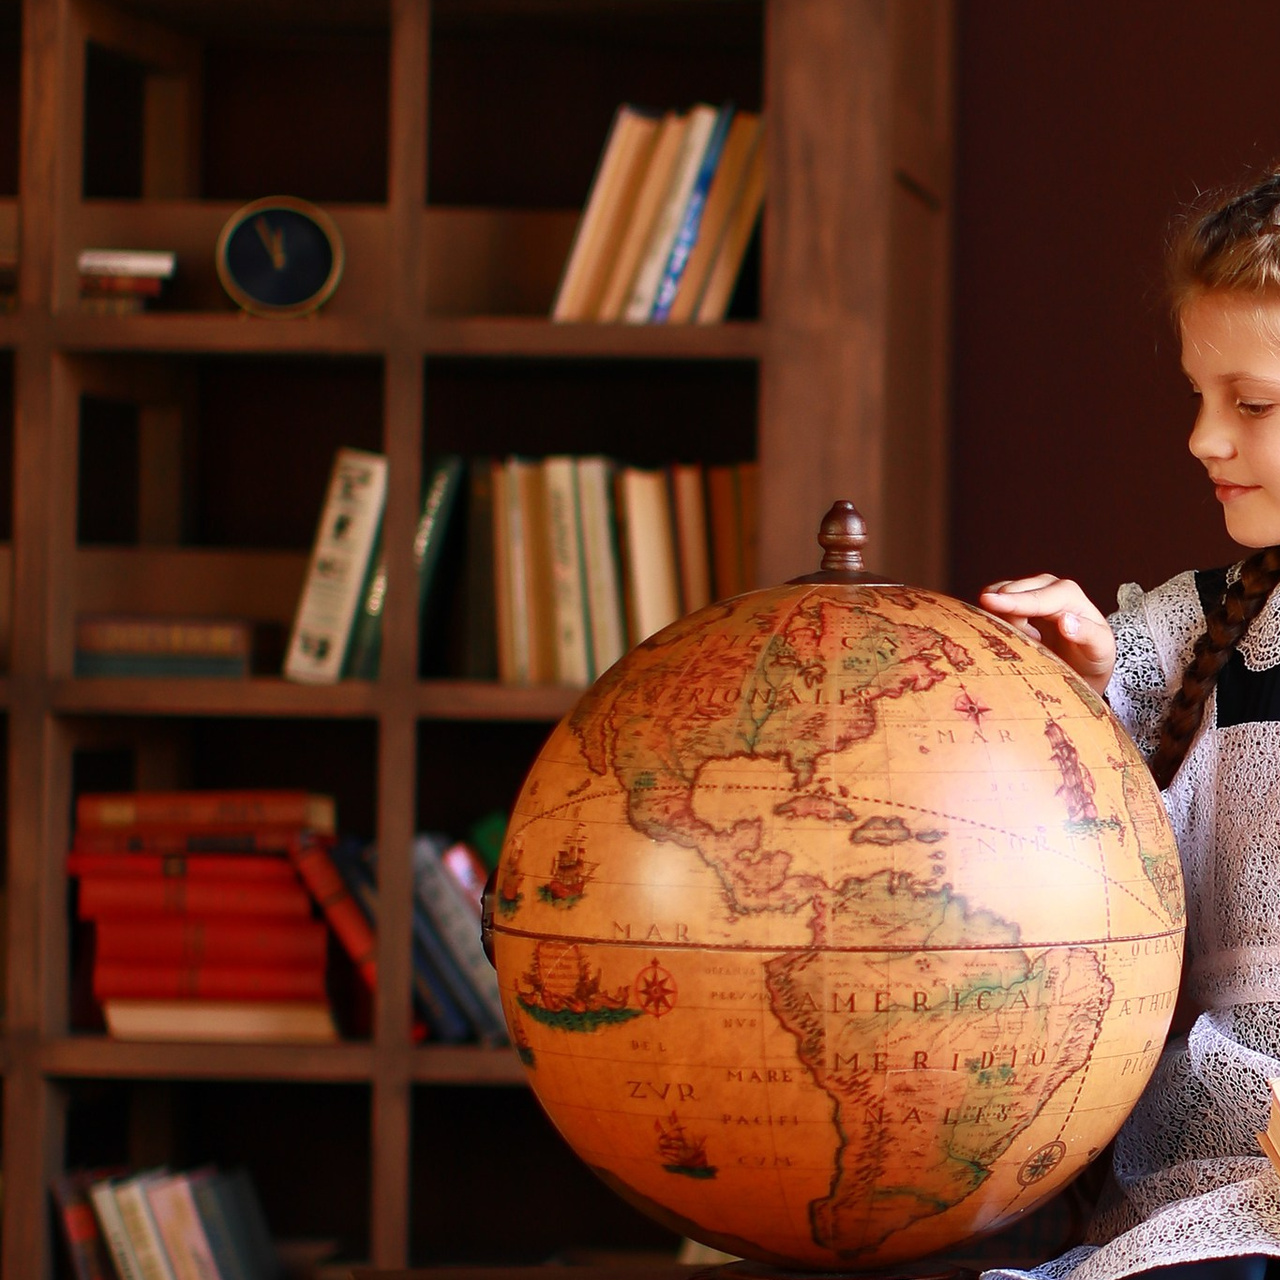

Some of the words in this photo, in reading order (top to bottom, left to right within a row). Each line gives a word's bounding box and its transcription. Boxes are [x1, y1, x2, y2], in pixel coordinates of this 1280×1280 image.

[938, 729, 1015, 744] MAR
[613, 922, 690, 942] MAR
[801, 989, 1031, 1013] AMERICA
[631, 1040, 667, 1053] DEL
[833, 1048, 1046, 1073] MERIDIO
[725, 1070, 793, 1084] MARE
[627, 1080, 700, 1102] ZVR
[862, 1105, 1009, 1126] NALIS
